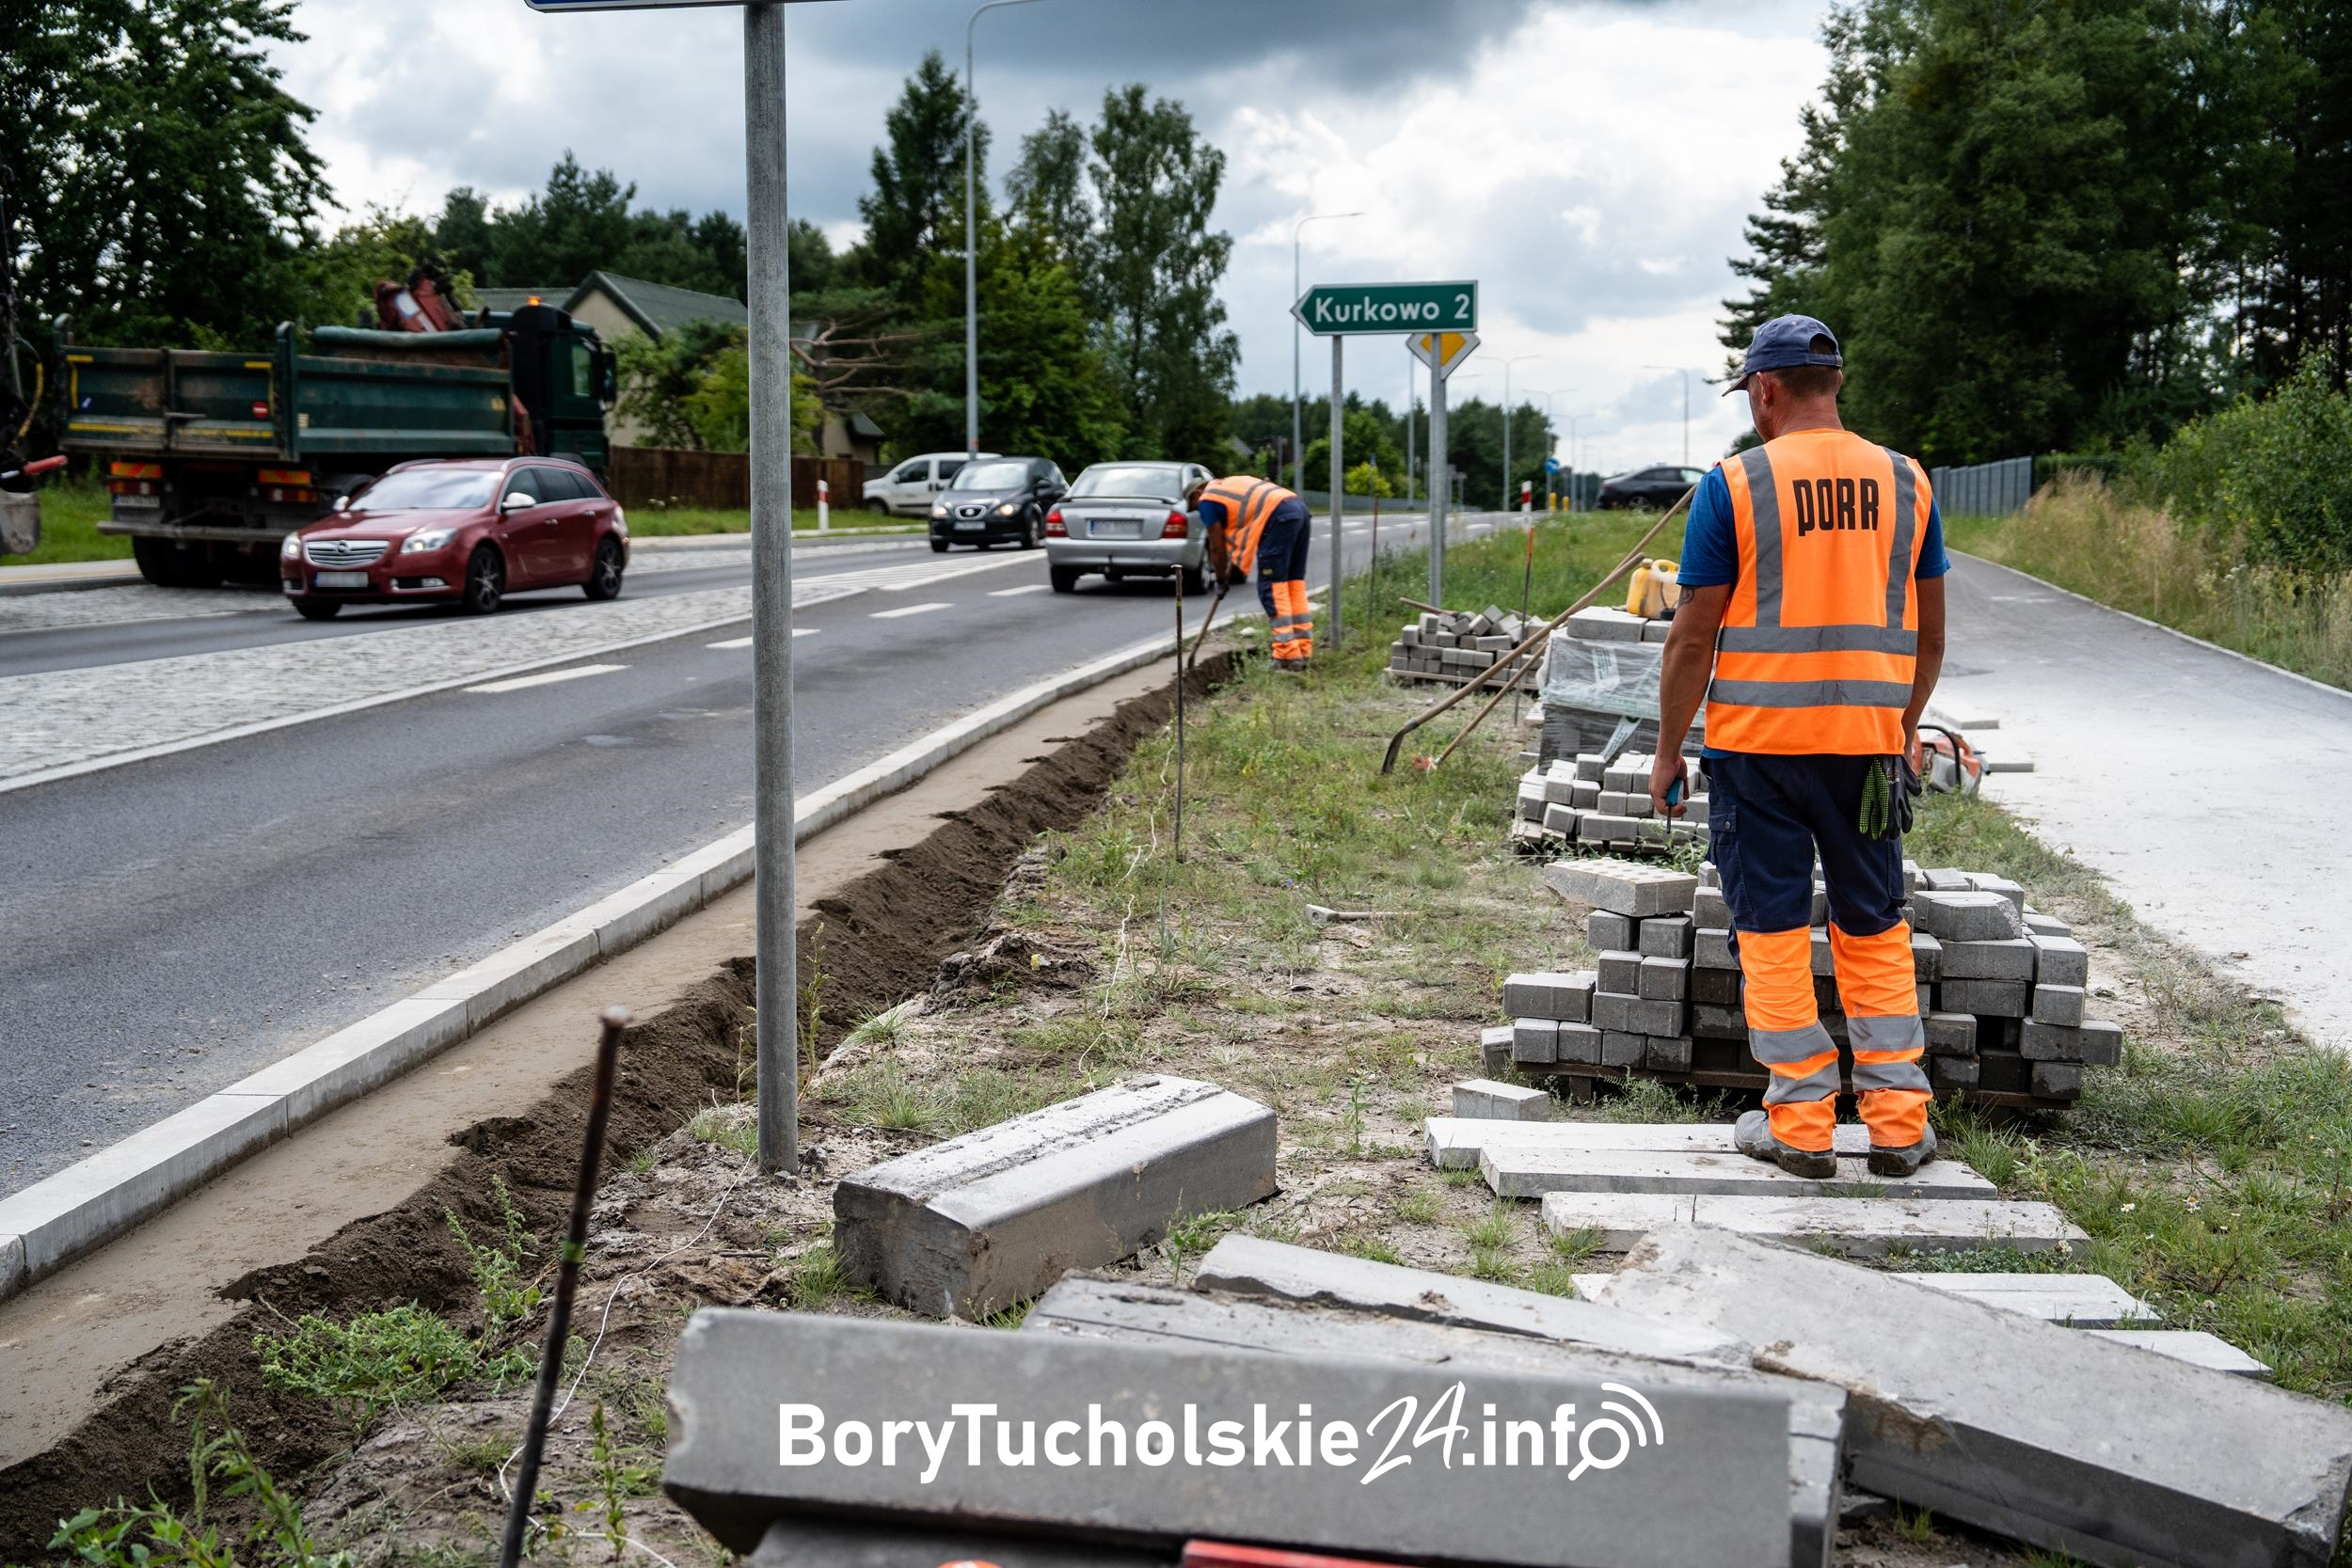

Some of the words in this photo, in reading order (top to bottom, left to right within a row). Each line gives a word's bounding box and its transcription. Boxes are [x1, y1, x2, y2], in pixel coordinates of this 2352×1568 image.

[1315, 296, 1439, 323] Kurkowo
[1454, 293, 1470, 320] 2
[1792, 478, 1880, 537] PORR
